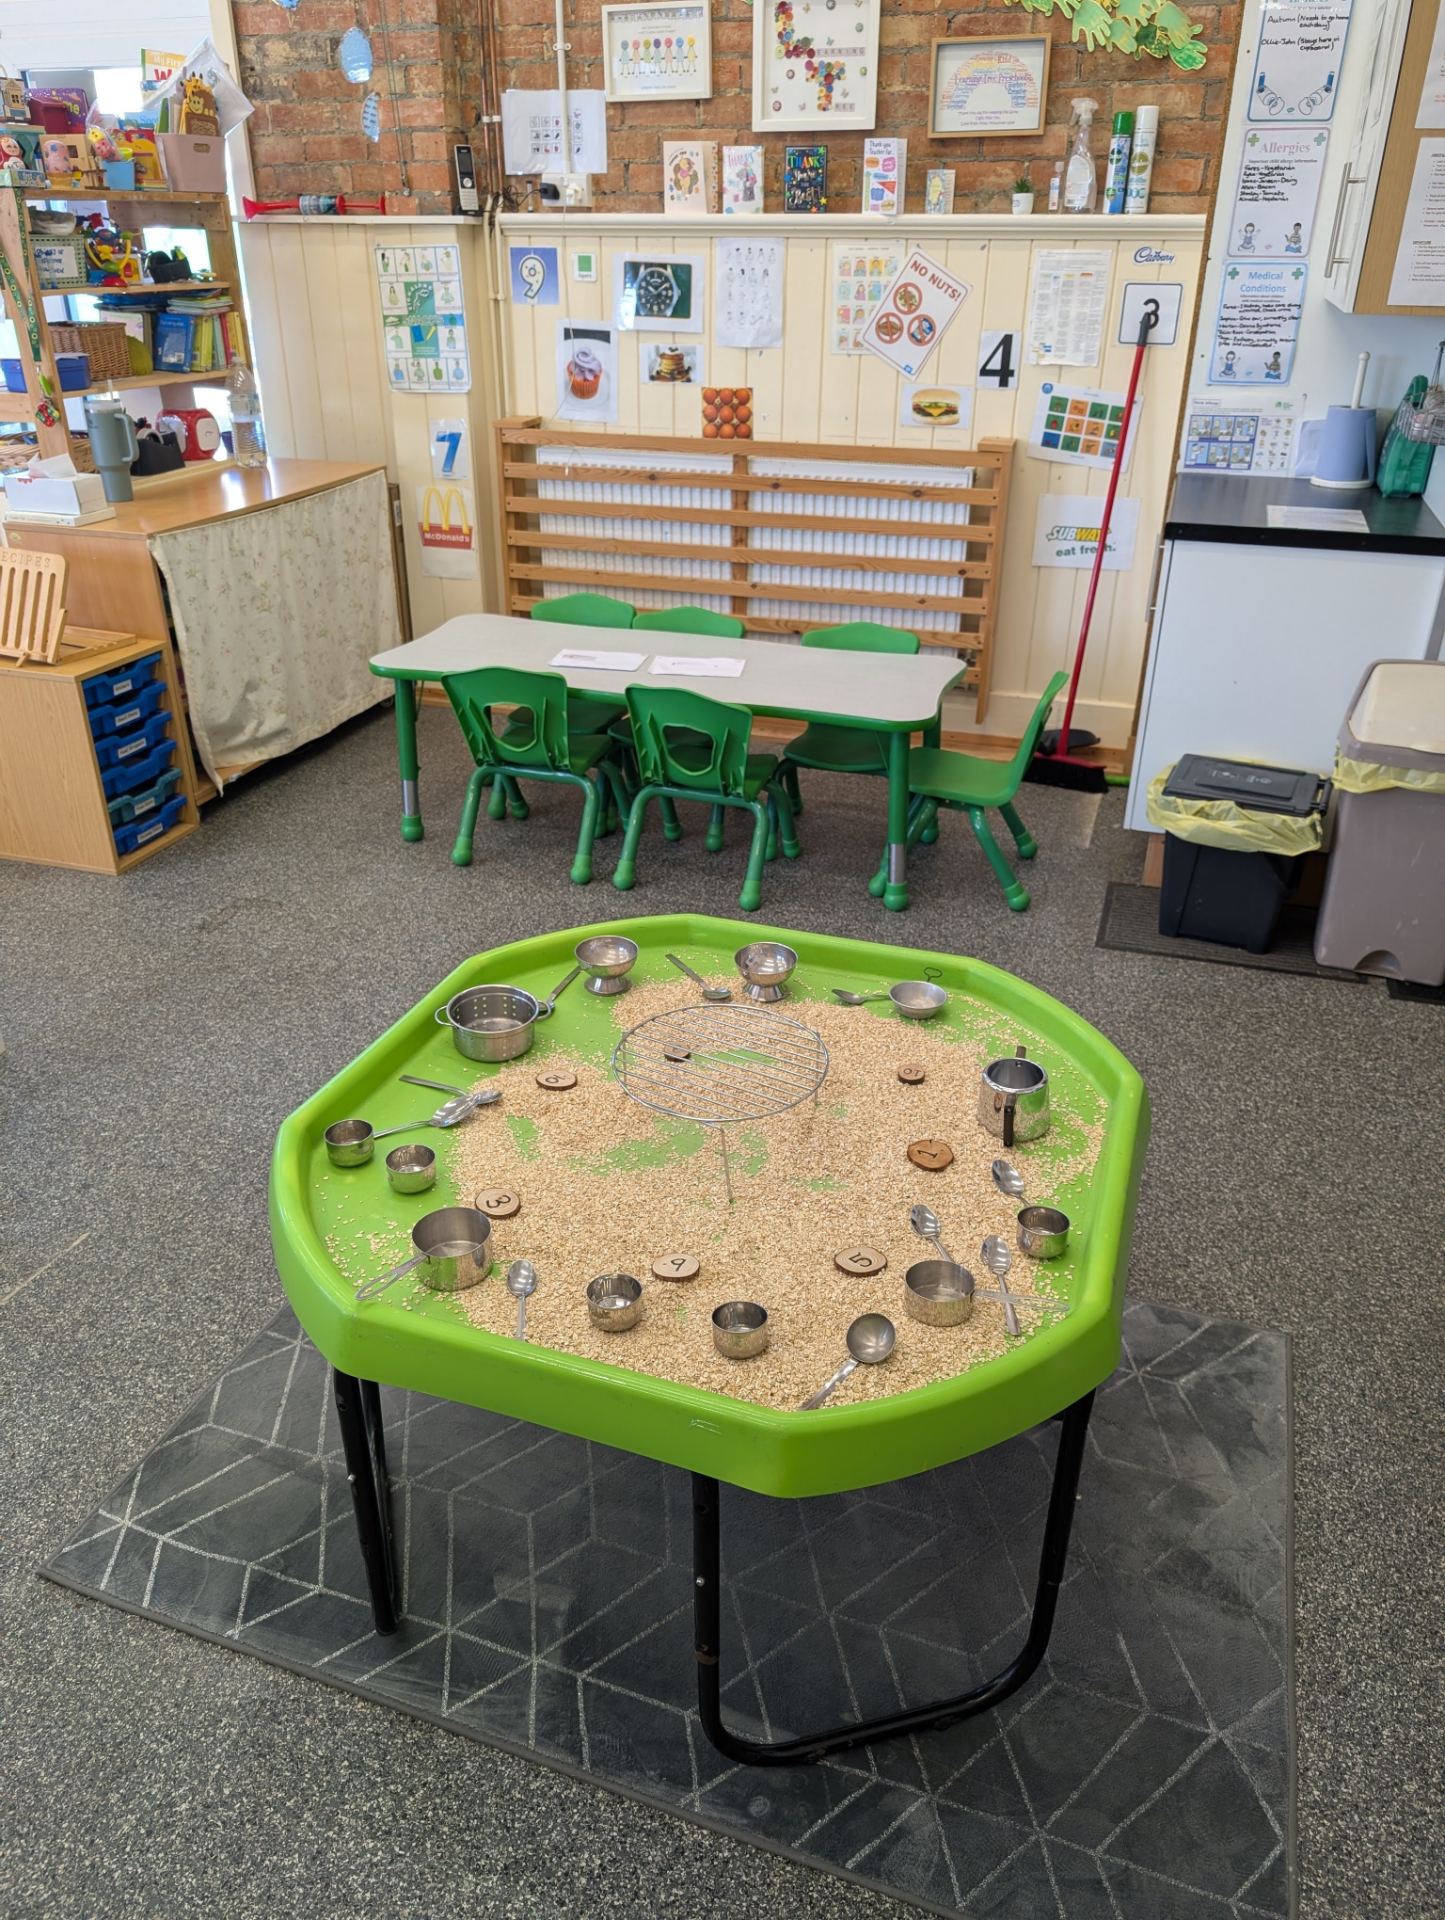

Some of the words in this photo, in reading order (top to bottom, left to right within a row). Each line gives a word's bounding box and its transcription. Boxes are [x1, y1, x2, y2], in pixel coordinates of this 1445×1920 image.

[1259, 142, 1311, 156] Allergies
[1134, 246, 1176, 264] Cadbury
[519, 254, 545, 300] 9
[910, 260, 928, 277] NO
[928, 273, 962, 302] NUTS!
[1248, 271, 1284, 280] Medical
[1240, 284, 1287, 293] Conditions
[1140, 298, 1160, 330] 3
[979, 334, 1015, 388] 4
[436, 431, 462, 473] 7
[1055, 546, 1076, 557] eat
[1080, 543, 1116, 555] freh.
[0, 551, 50, 568] ECIPES
[486, 1194, 511, 1209] 3
[848, 1252, 872, 1267] 5
